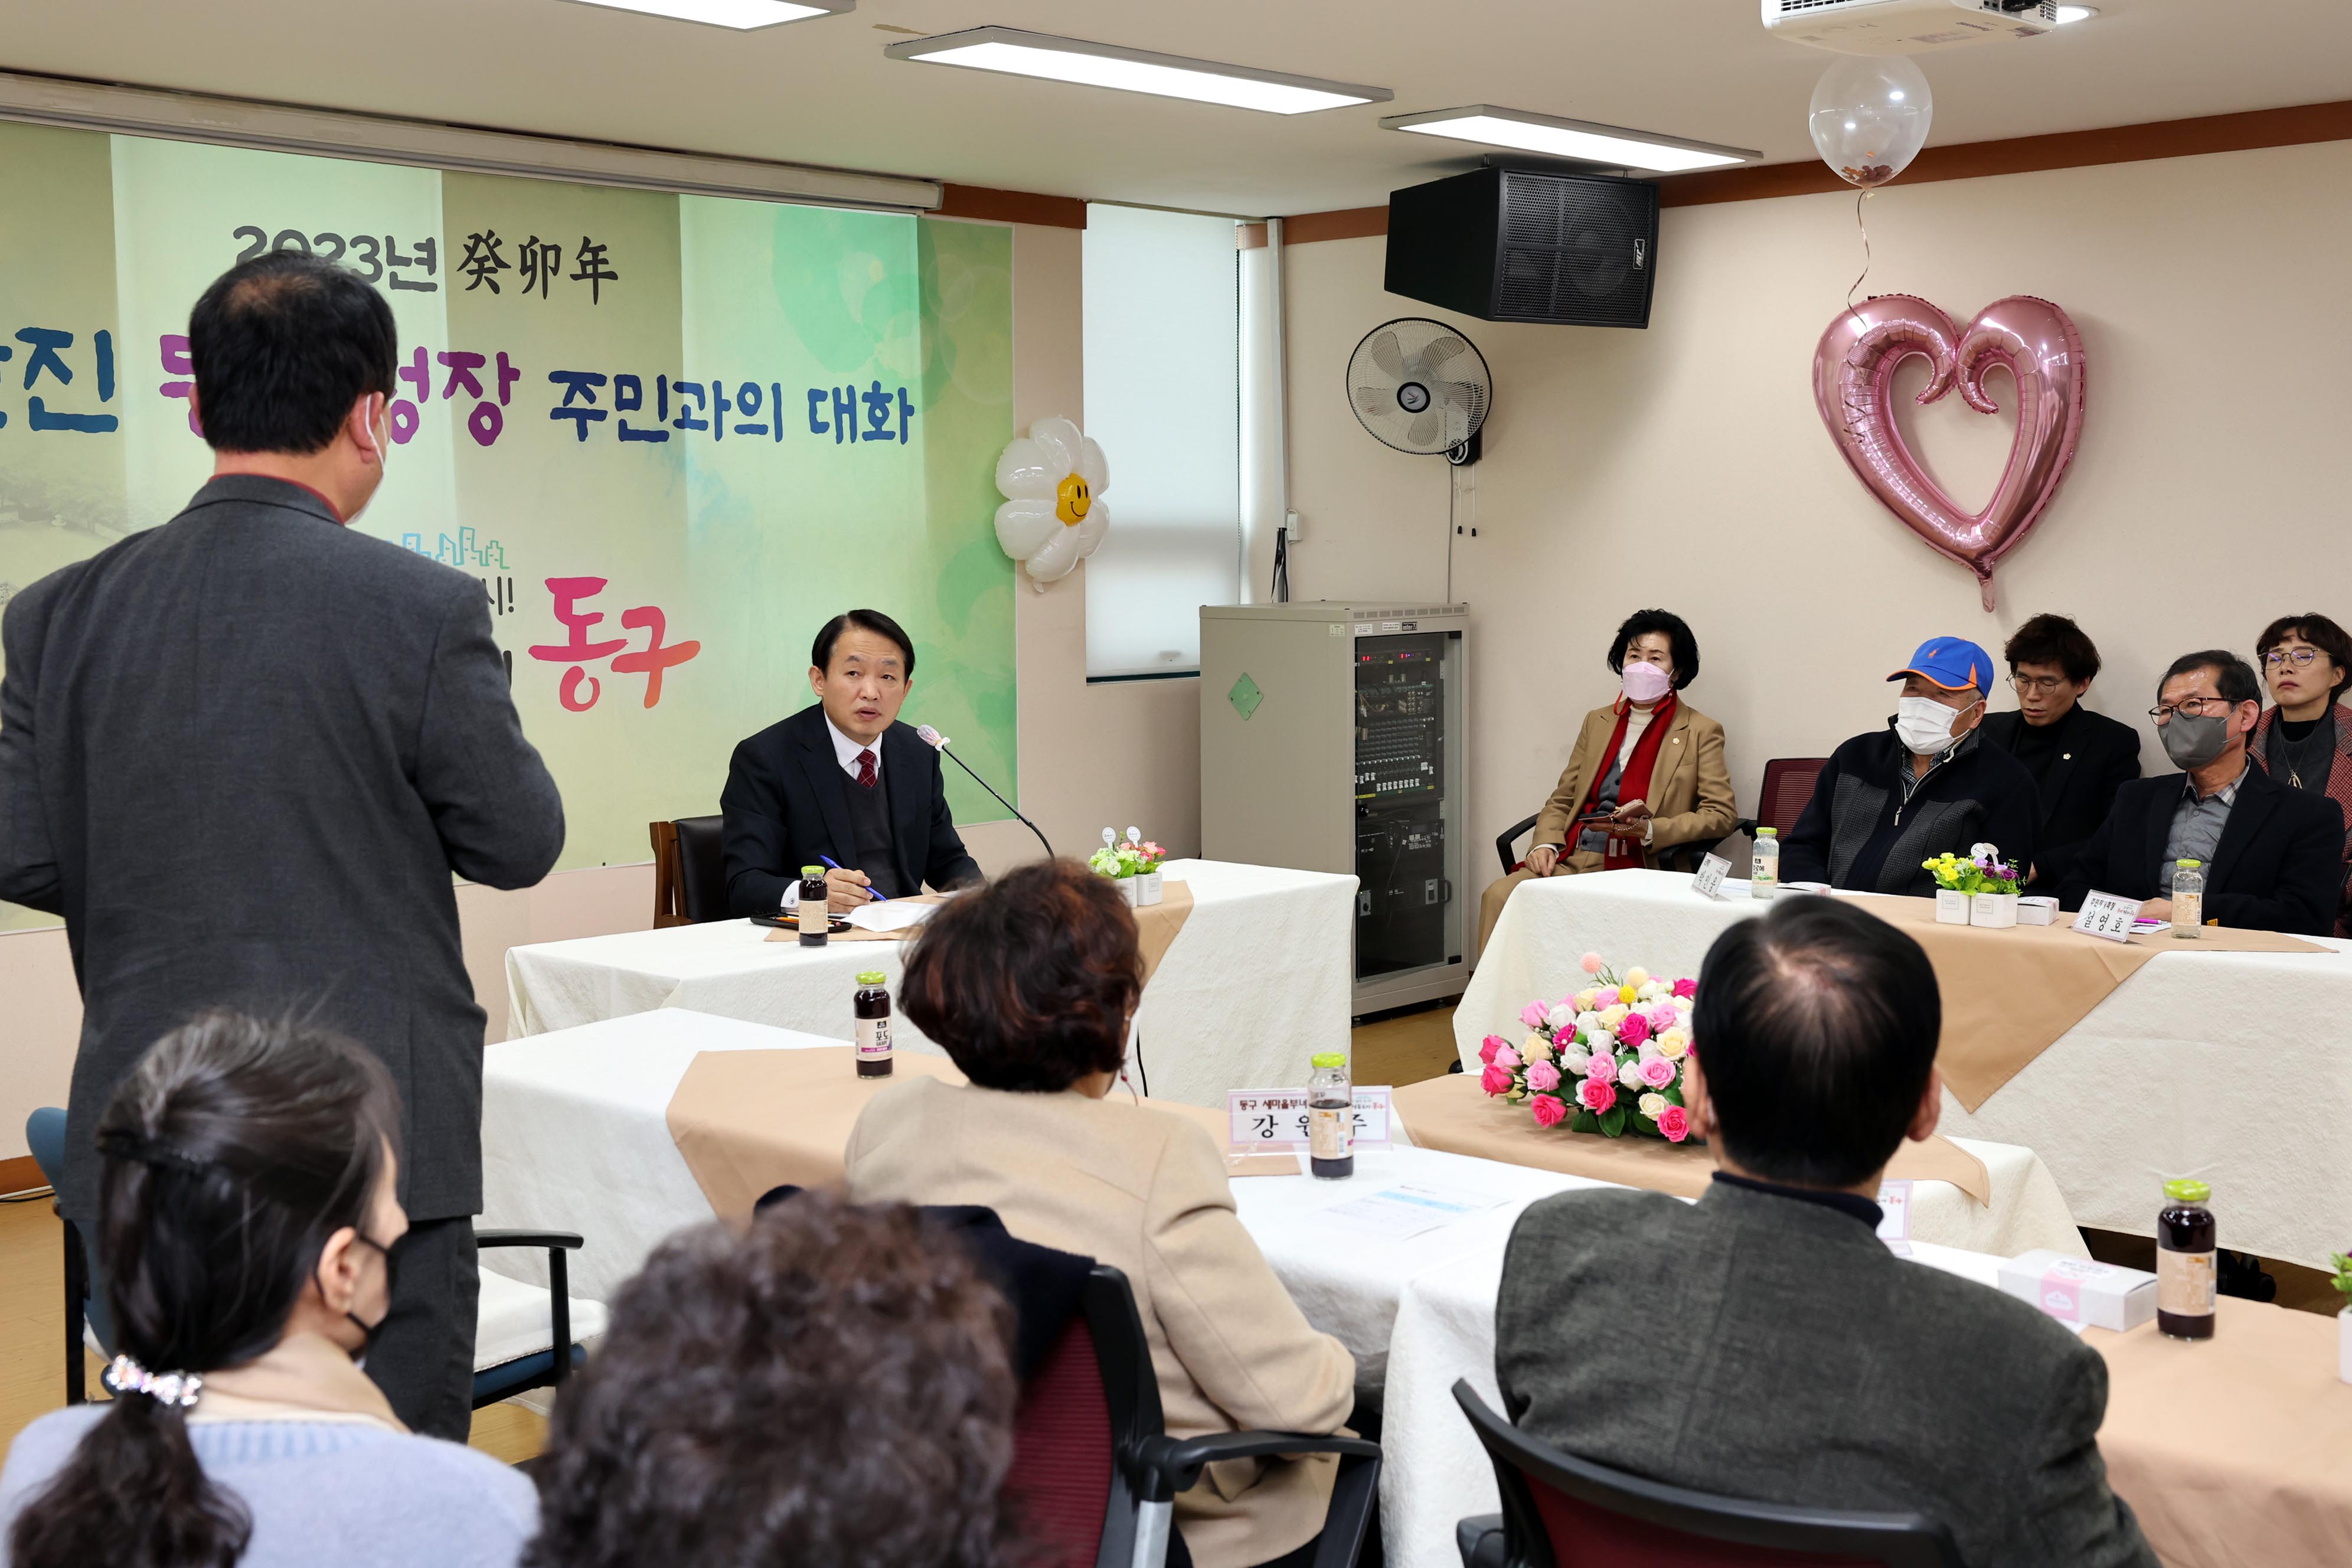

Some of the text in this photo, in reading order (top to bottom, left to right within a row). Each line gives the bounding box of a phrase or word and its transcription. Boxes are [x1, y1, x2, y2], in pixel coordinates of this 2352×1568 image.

[457, 229, 618, 305] 癸卯年
[0, 326, 118, 433] 진
[548, 370, 784, 443] 주민과의
[808, 380, 915, 445] 대화
[528, 577, 701, 712] 동구
[876, 1030, 888, 1041] 포도
[1240, 1099, 1308, 1110] 동구 새마을부녀
